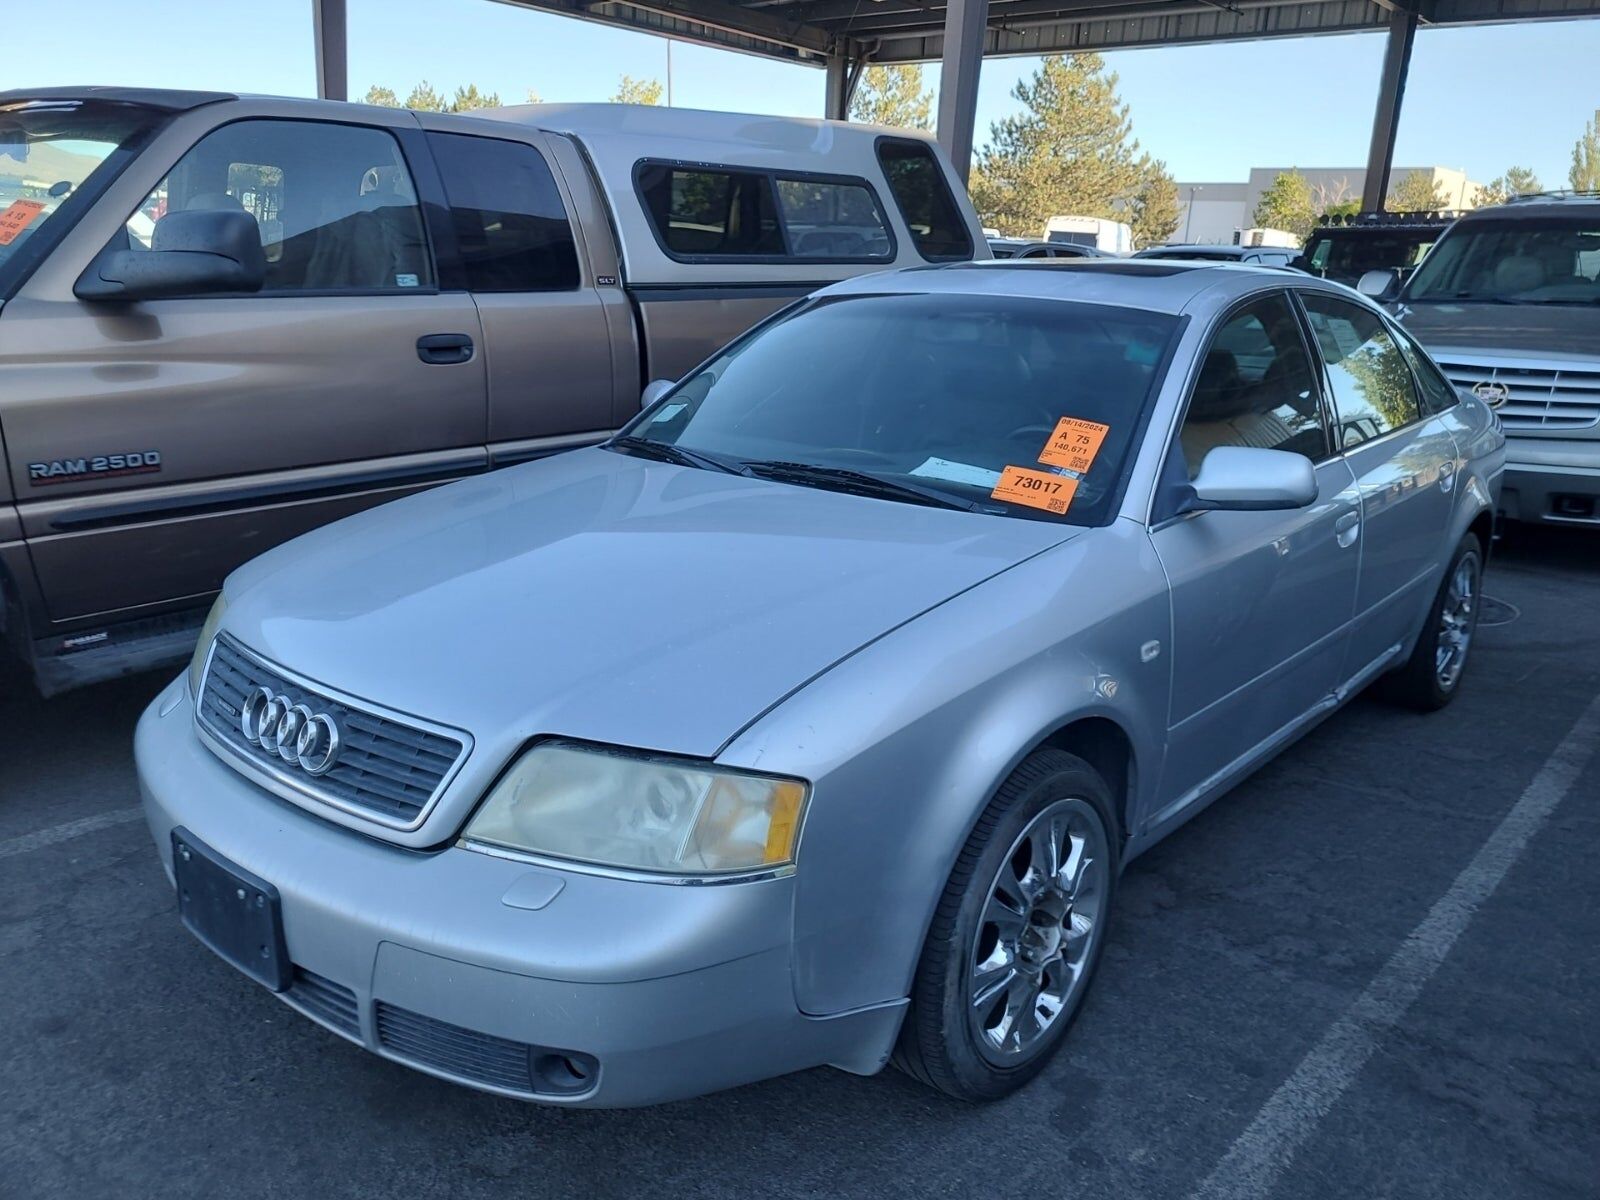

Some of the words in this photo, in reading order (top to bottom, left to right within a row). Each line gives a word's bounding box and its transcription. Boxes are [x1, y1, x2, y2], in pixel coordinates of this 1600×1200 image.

[1059, 431, 1068, 441] A
[1076, 434, 1090, 445] 75
[1054, 442, 1087, 454] 140,671
[28, 458, 87, 479] RAM
[91, 450, 161, 472] 2500
[1014, 475, 1062, 494] 73017
